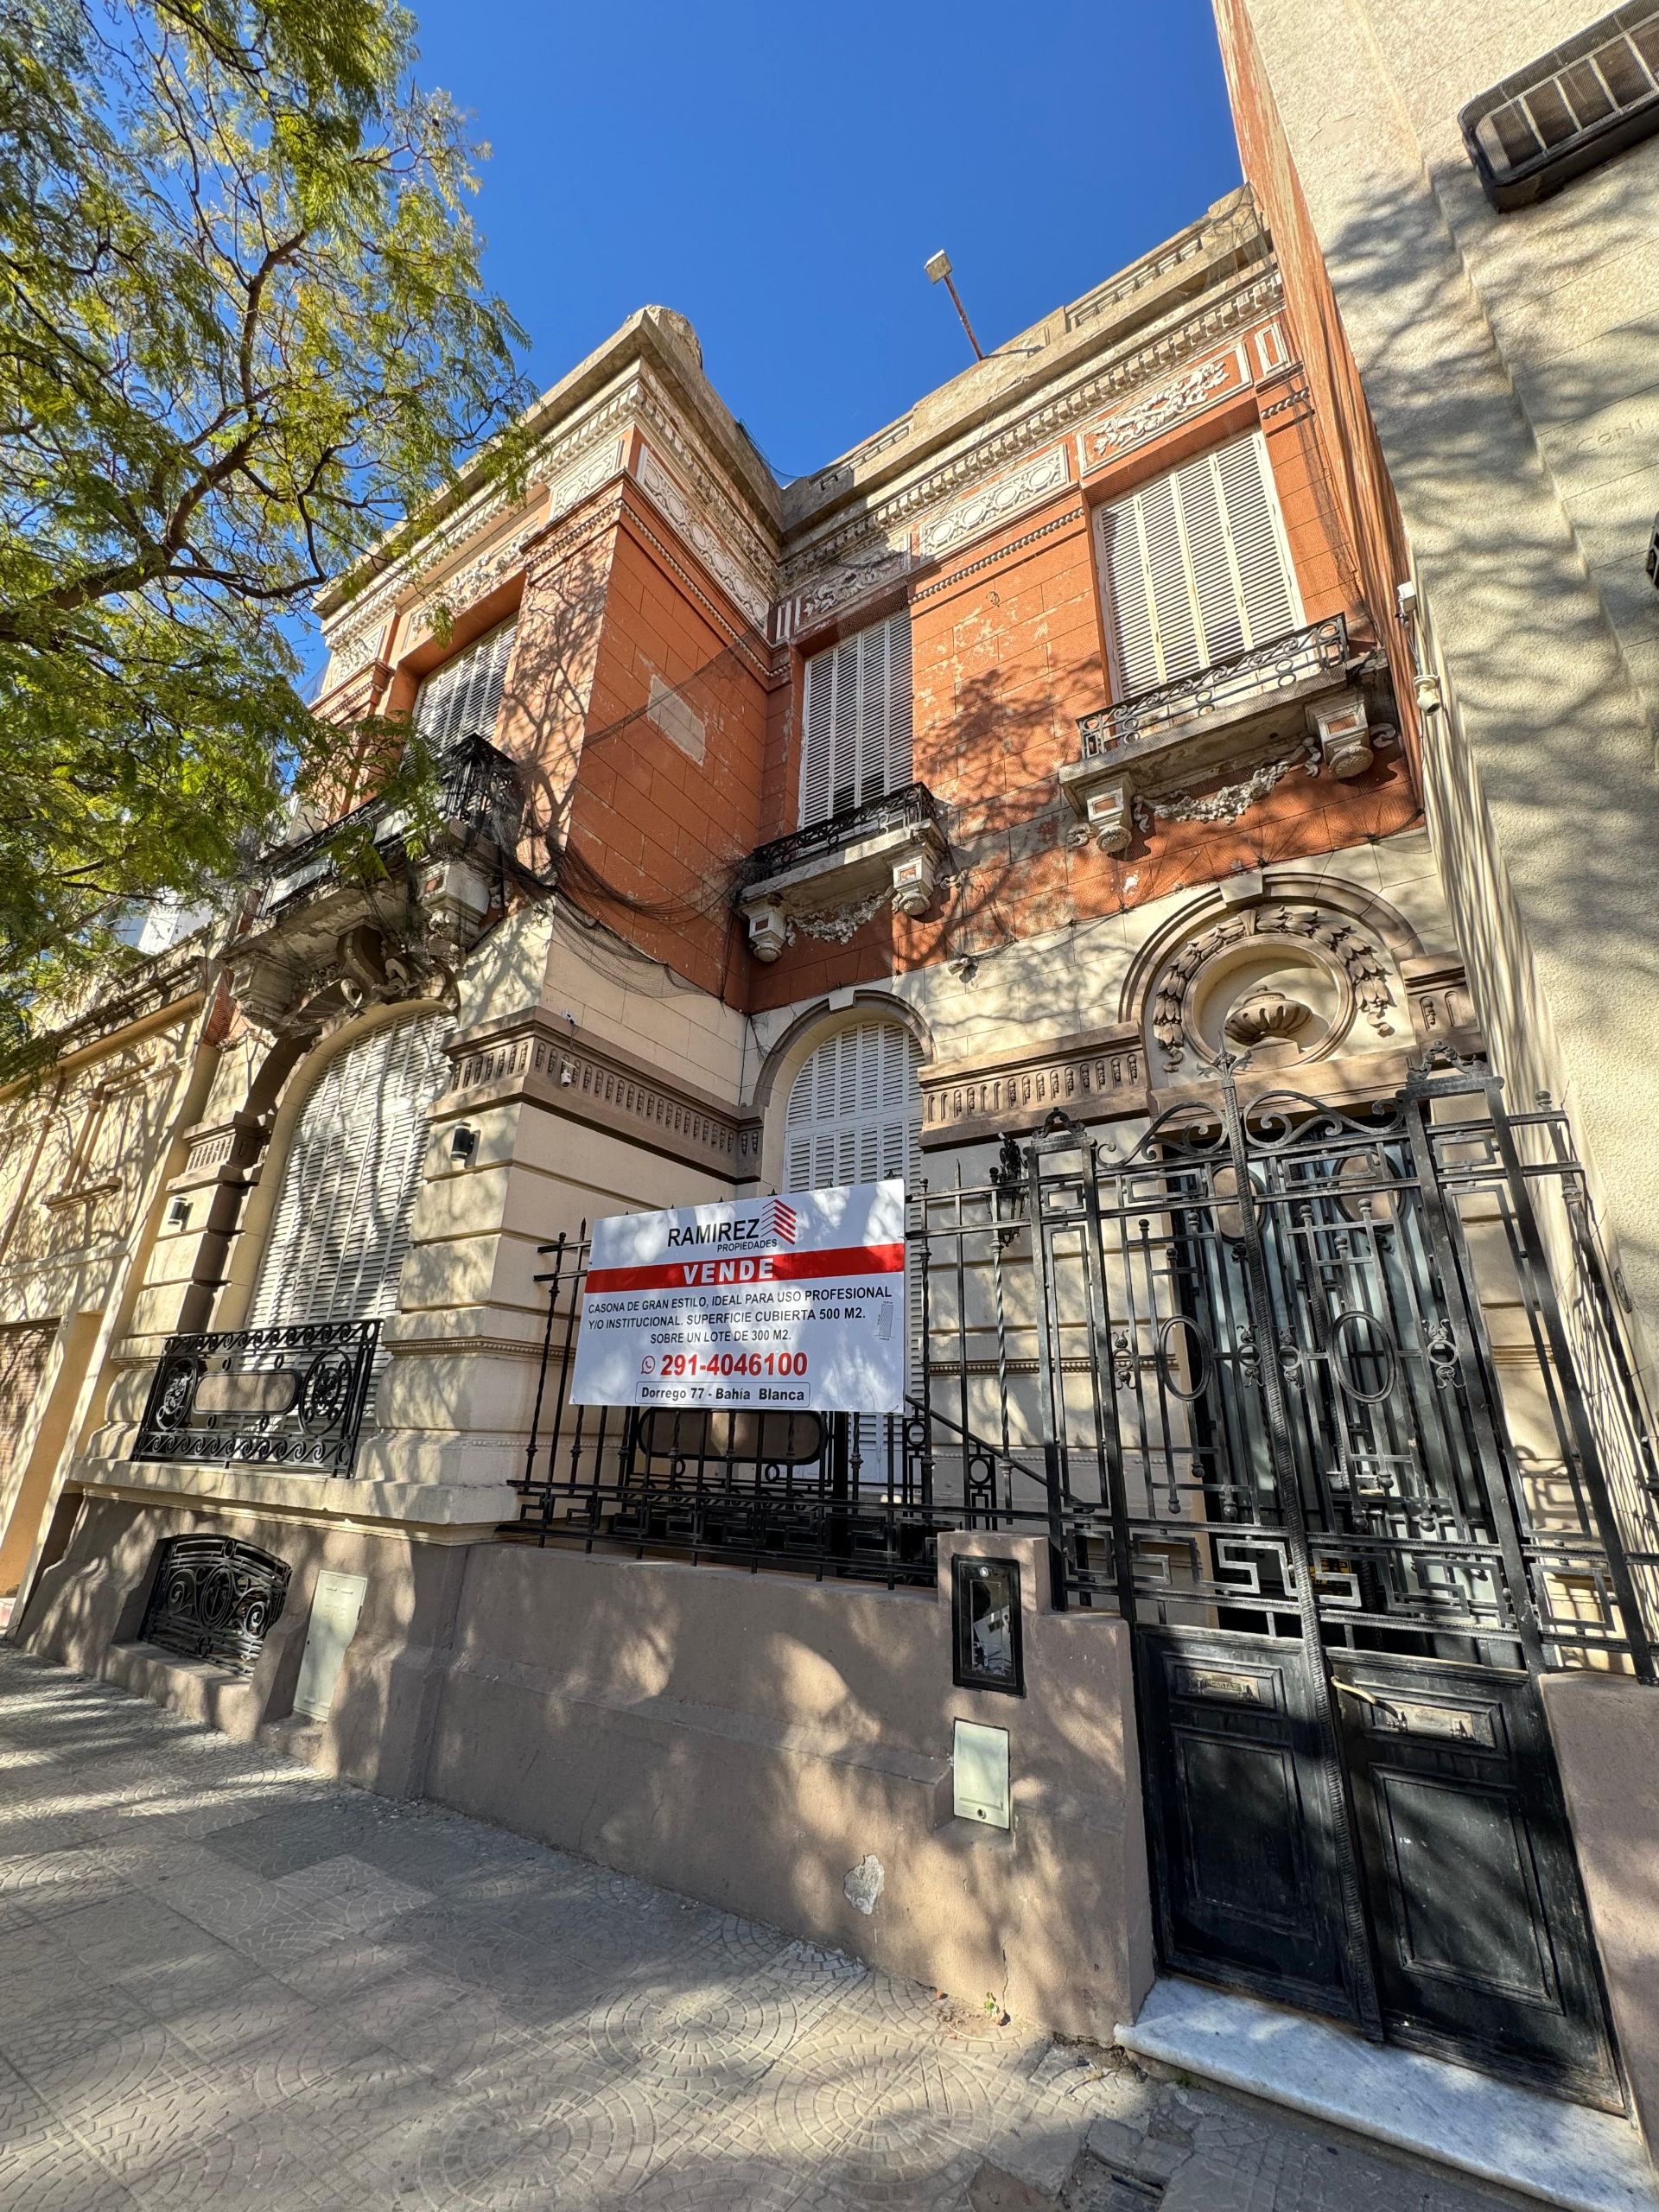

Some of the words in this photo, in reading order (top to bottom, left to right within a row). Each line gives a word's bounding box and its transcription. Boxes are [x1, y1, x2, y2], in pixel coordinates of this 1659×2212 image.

[667, 1218, 760, 1247] RAMIREZ
[717, 1238, 778, 1252] PROPIEDADES
[683, 1257, 774, 1285] VENDE
[588, 1302, 625, 1313] CASONA
[626, 1300, 639, 1312] DE
[642, 1300, 669, 1310] GRAN
[671, 1297, 709, 1308] ESTILO,
[712, 1294, 741, 1306] IDEAL
[745, 1293, 774, 1304] PARA
[777, 1291, 801, 1302] USO
[804, 1286, 892, 1301] PROFESIONAL
[588, 1319, 604, 1330] Y/O
[606, 1316, 683, 1329] INSTITUCIONAL.
[686, 1312, 752, 1325] SUPERFICIE
[755, 1309, 816, 1322] CUBIERTA
[819, 1308, 840, 1319] 500
[844, 1307, 866, 1319] M2.
[650, 1332, 684, 1344] SOBRE
[687, 1332, 702, 1343] UN
[704, 1331, 731, 1342] LOTE
[734, 1331, 748, 1342] DE
[752, 1330, 769, 1341] 300
[772, 1329, 791, 1340] M2.
[660, 1352, 808, 1376] 291-4046100
[642, 1387, 687, 1401] Dorrego
[690, 1388, 705, 1399] 77
[715, 1388, 751, 1400] Bahía
[759, 1388, 804, 1401] Blanca
